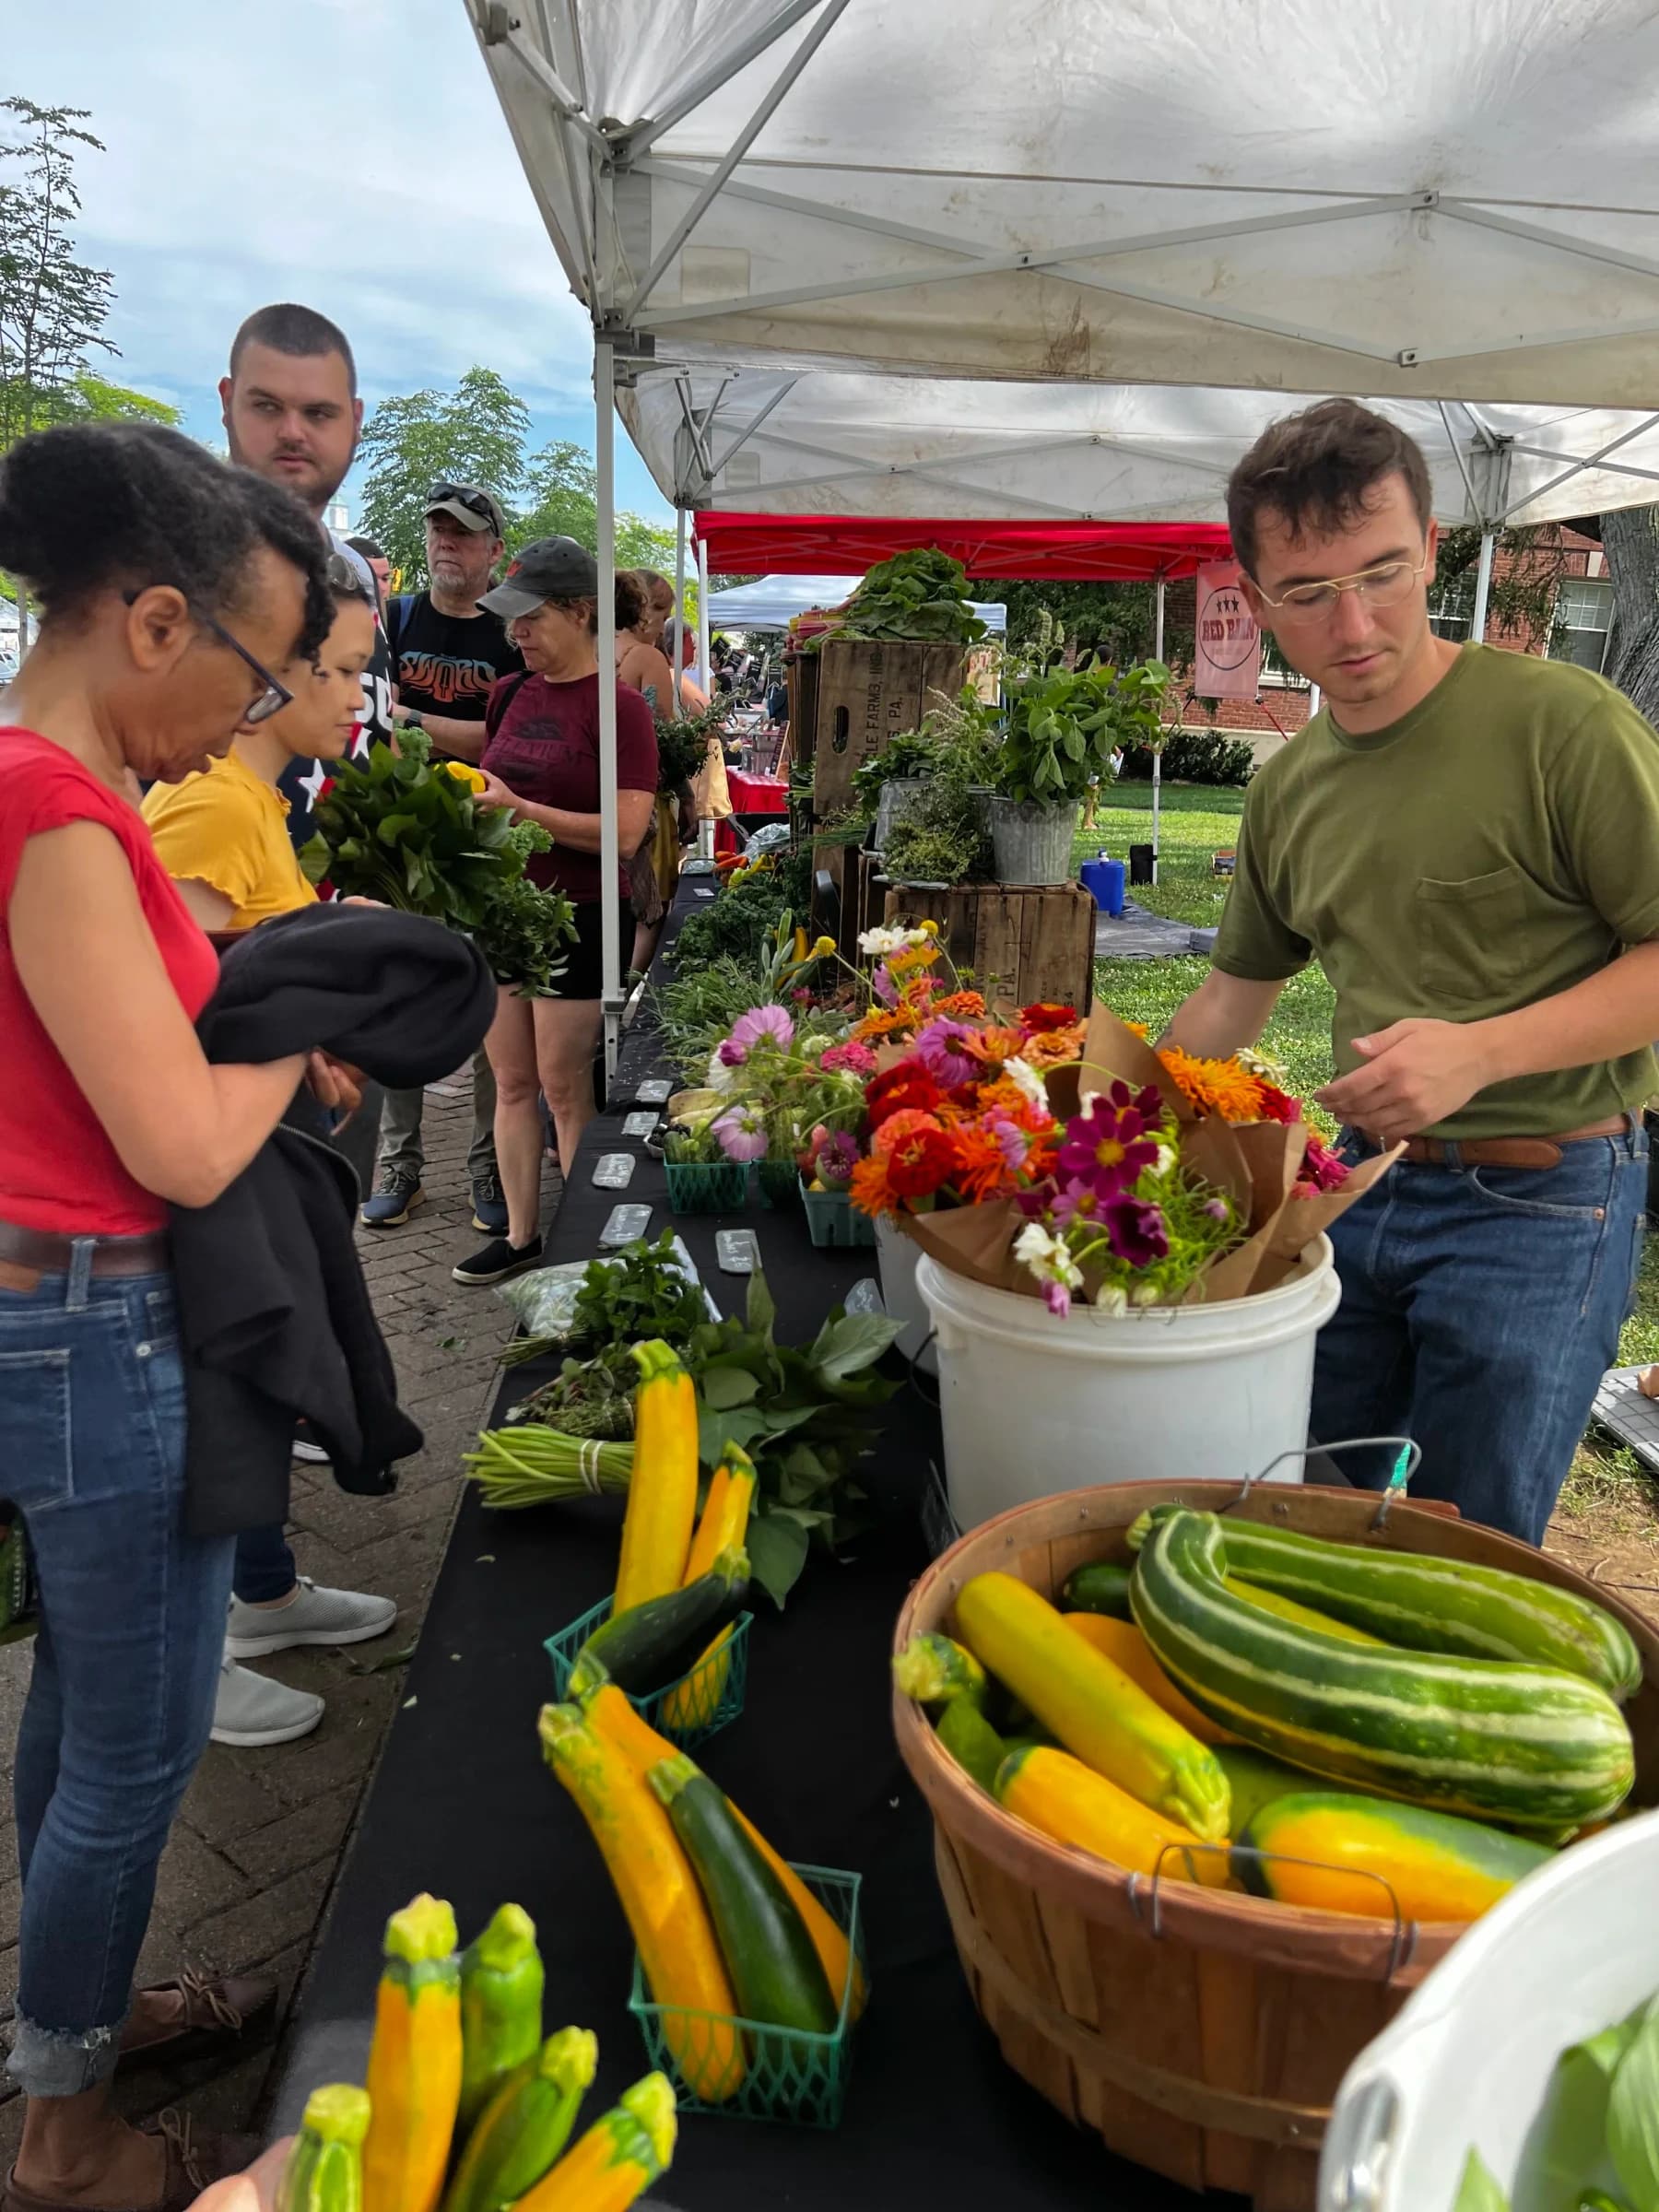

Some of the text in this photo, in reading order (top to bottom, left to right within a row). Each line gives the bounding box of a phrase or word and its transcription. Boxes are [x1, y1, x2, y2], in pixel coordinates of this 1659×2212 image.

[1202, 619, 1225, 641] RED
[399, 651, 498, 702] SWORD
[888, 697, 904, 719] PA.
